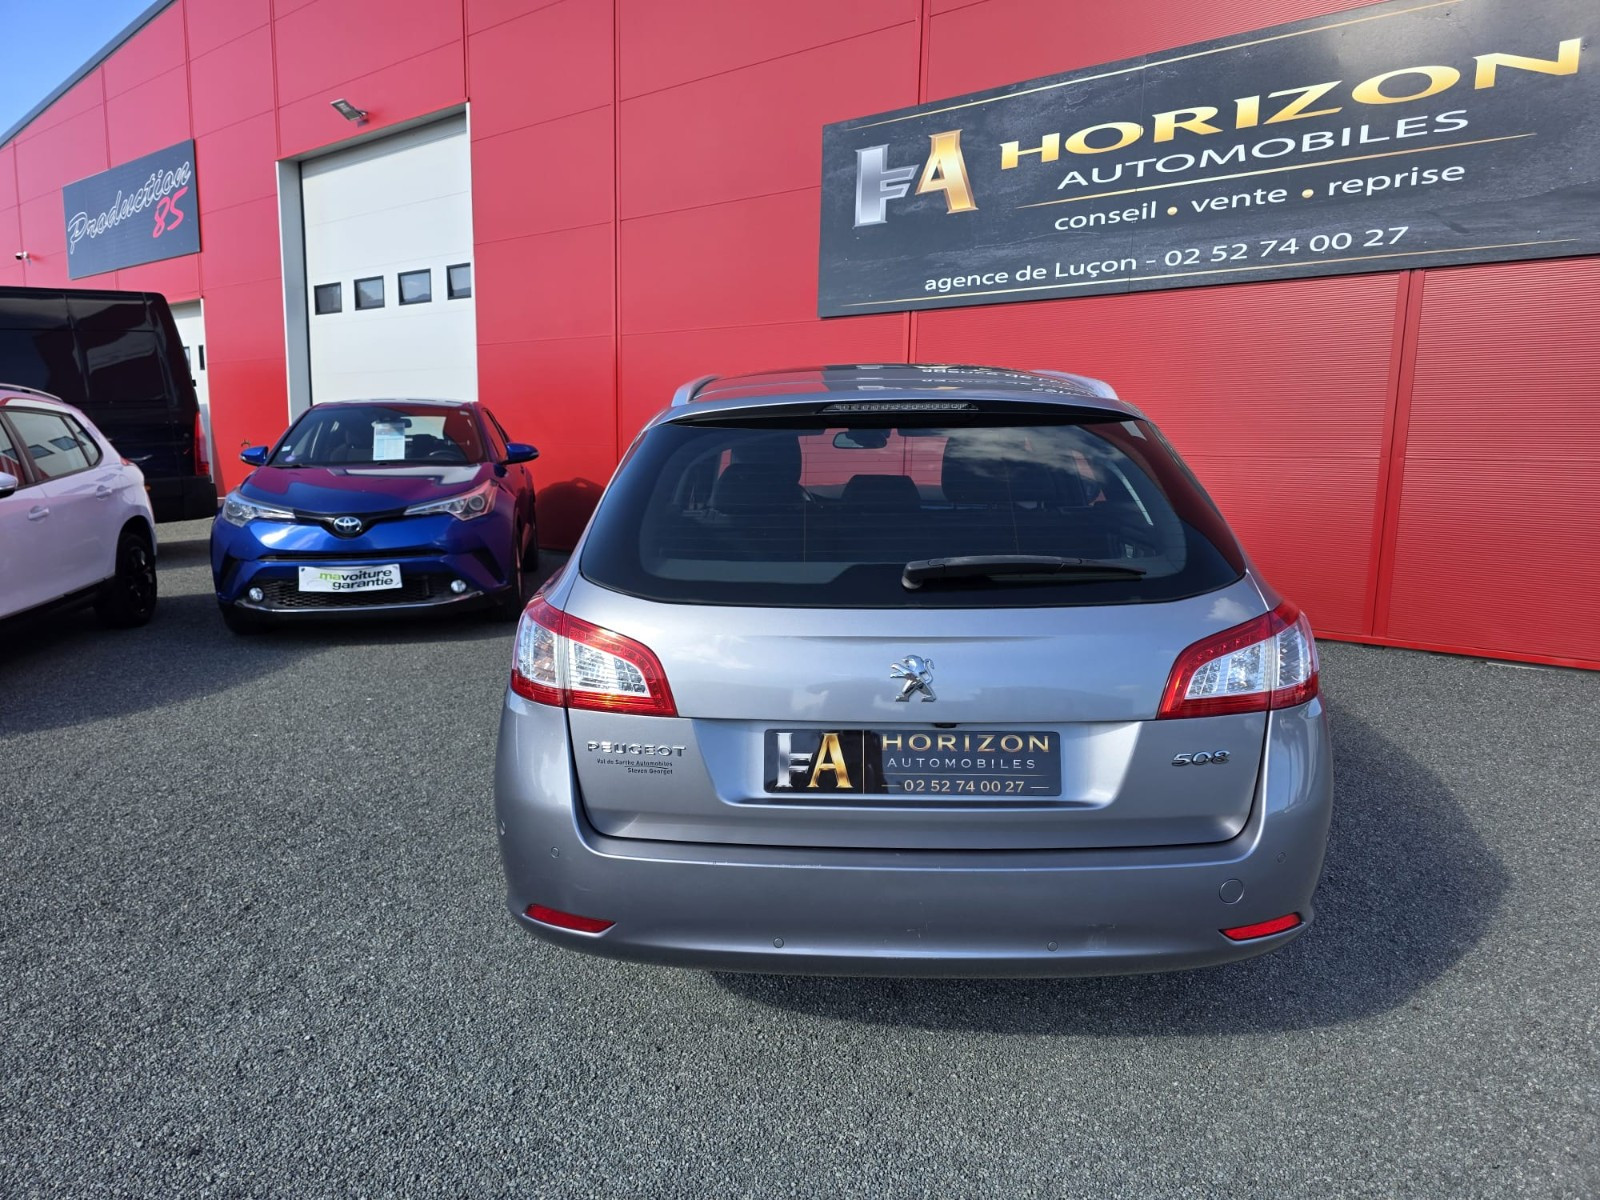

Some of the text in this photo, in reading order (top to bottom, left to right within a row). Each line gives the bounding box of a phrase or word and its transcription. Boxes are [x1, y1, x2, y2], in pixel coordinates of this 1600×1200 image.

[1000, 37, 1582, 170] HORIZON
[1056, 109, 1469, 190] AUTOMOBILES
[67, 161, 192, 255] Production
[153, 186, 189, 238] 85
[1054, 165, 1466, 231] conseil vente reprise
[924, 272, 1009, 293] agence
[1015, 265, 1047, 282] de
[1055, 256, 1137, 278] Luçon
[1164, 249, 1200, 267] 02
[1210, 243, 1249, 262] 52
[1260, 238, 1300, 257] 74
[1309, 232, 1353, 252] 00
[1364, 226, 1409, 247] 27
[332, 577, 394, 590] garantie
[587, 741, 687, 757] PEUGEOT
[881, 733, 1050, 753] HORIZON
[1171, 750, 1231, 767] 508
[887, 757, 1036, 769] AUTOMOBILES
[903, 779, 1025, 793] 02 52 74 00 27
